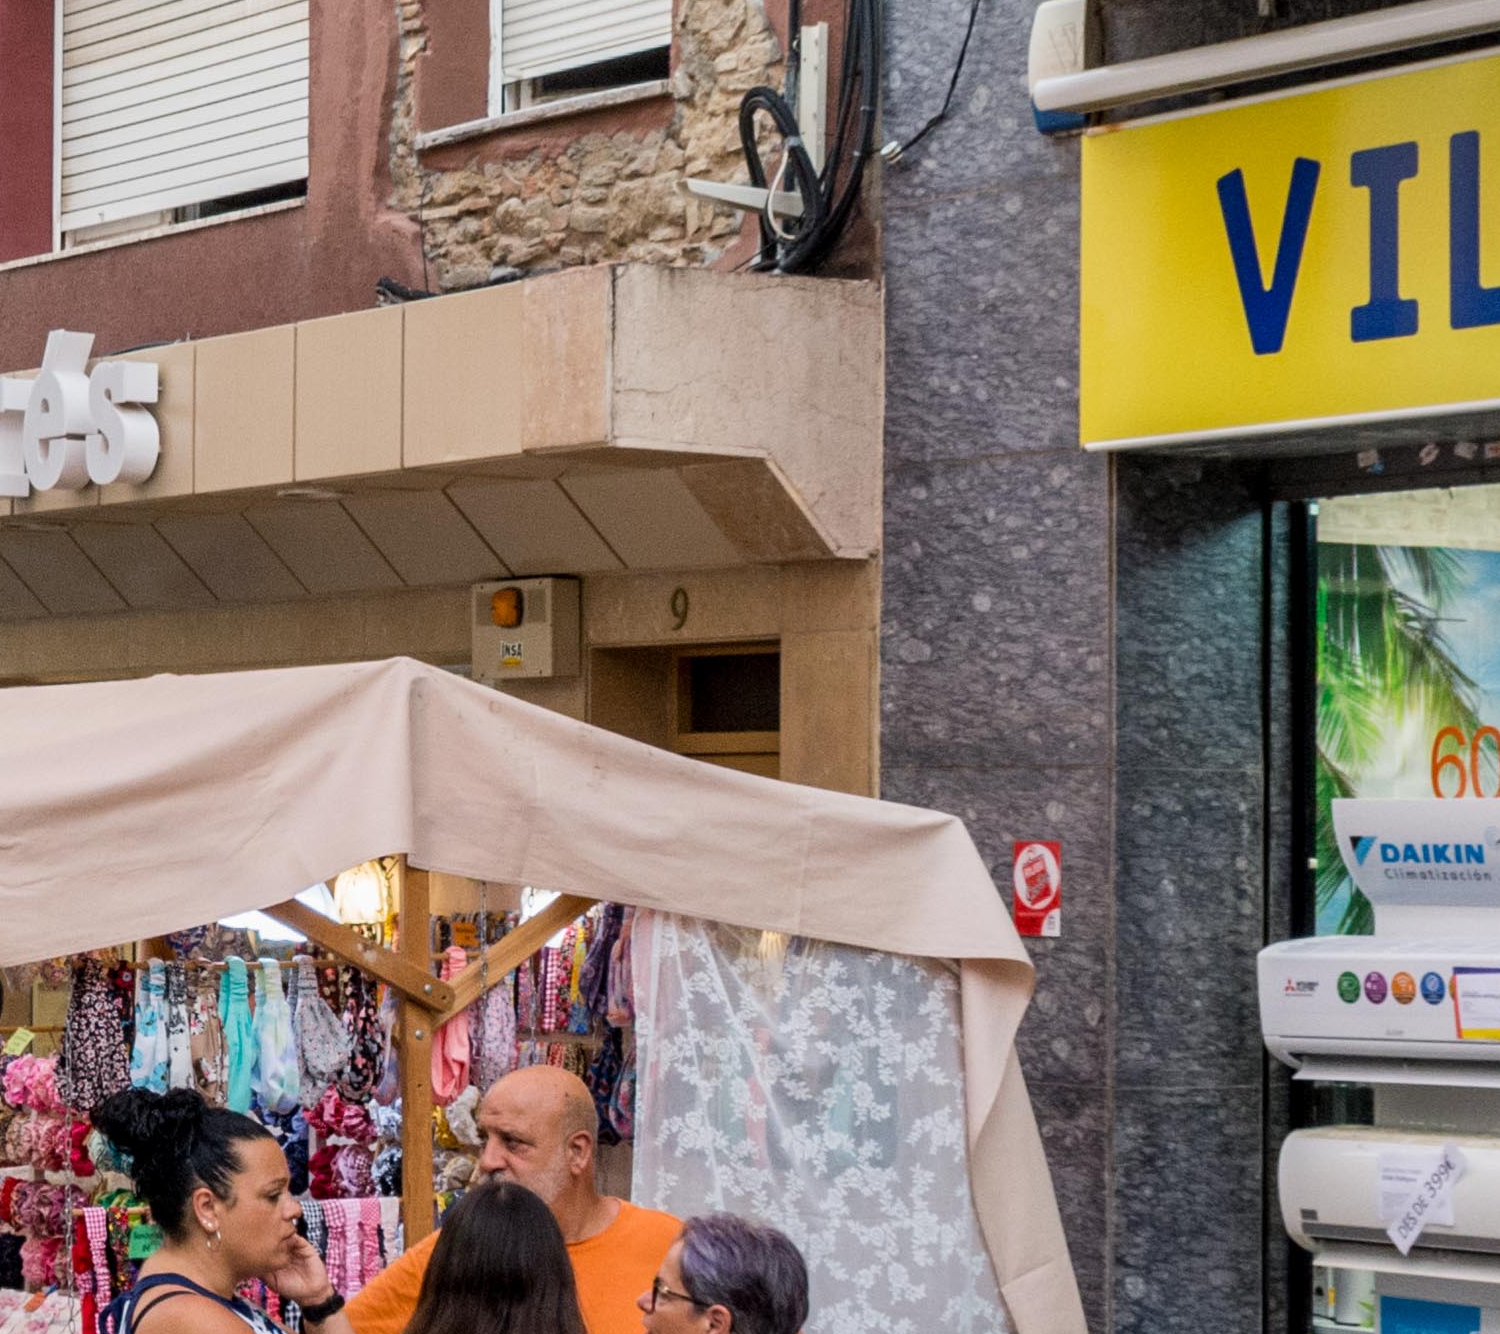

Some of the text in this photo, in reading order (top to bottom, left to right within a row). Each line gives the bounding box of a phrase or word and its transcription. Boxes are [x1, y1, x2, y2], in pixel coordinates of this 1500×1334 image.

[670, 587, 689, 631] 9
[1379, 843, 1485, 865] DAIKIN
[1383, 867, 1493, 882] Climatización
[1423, 1154, 1456, 1199] 399€
